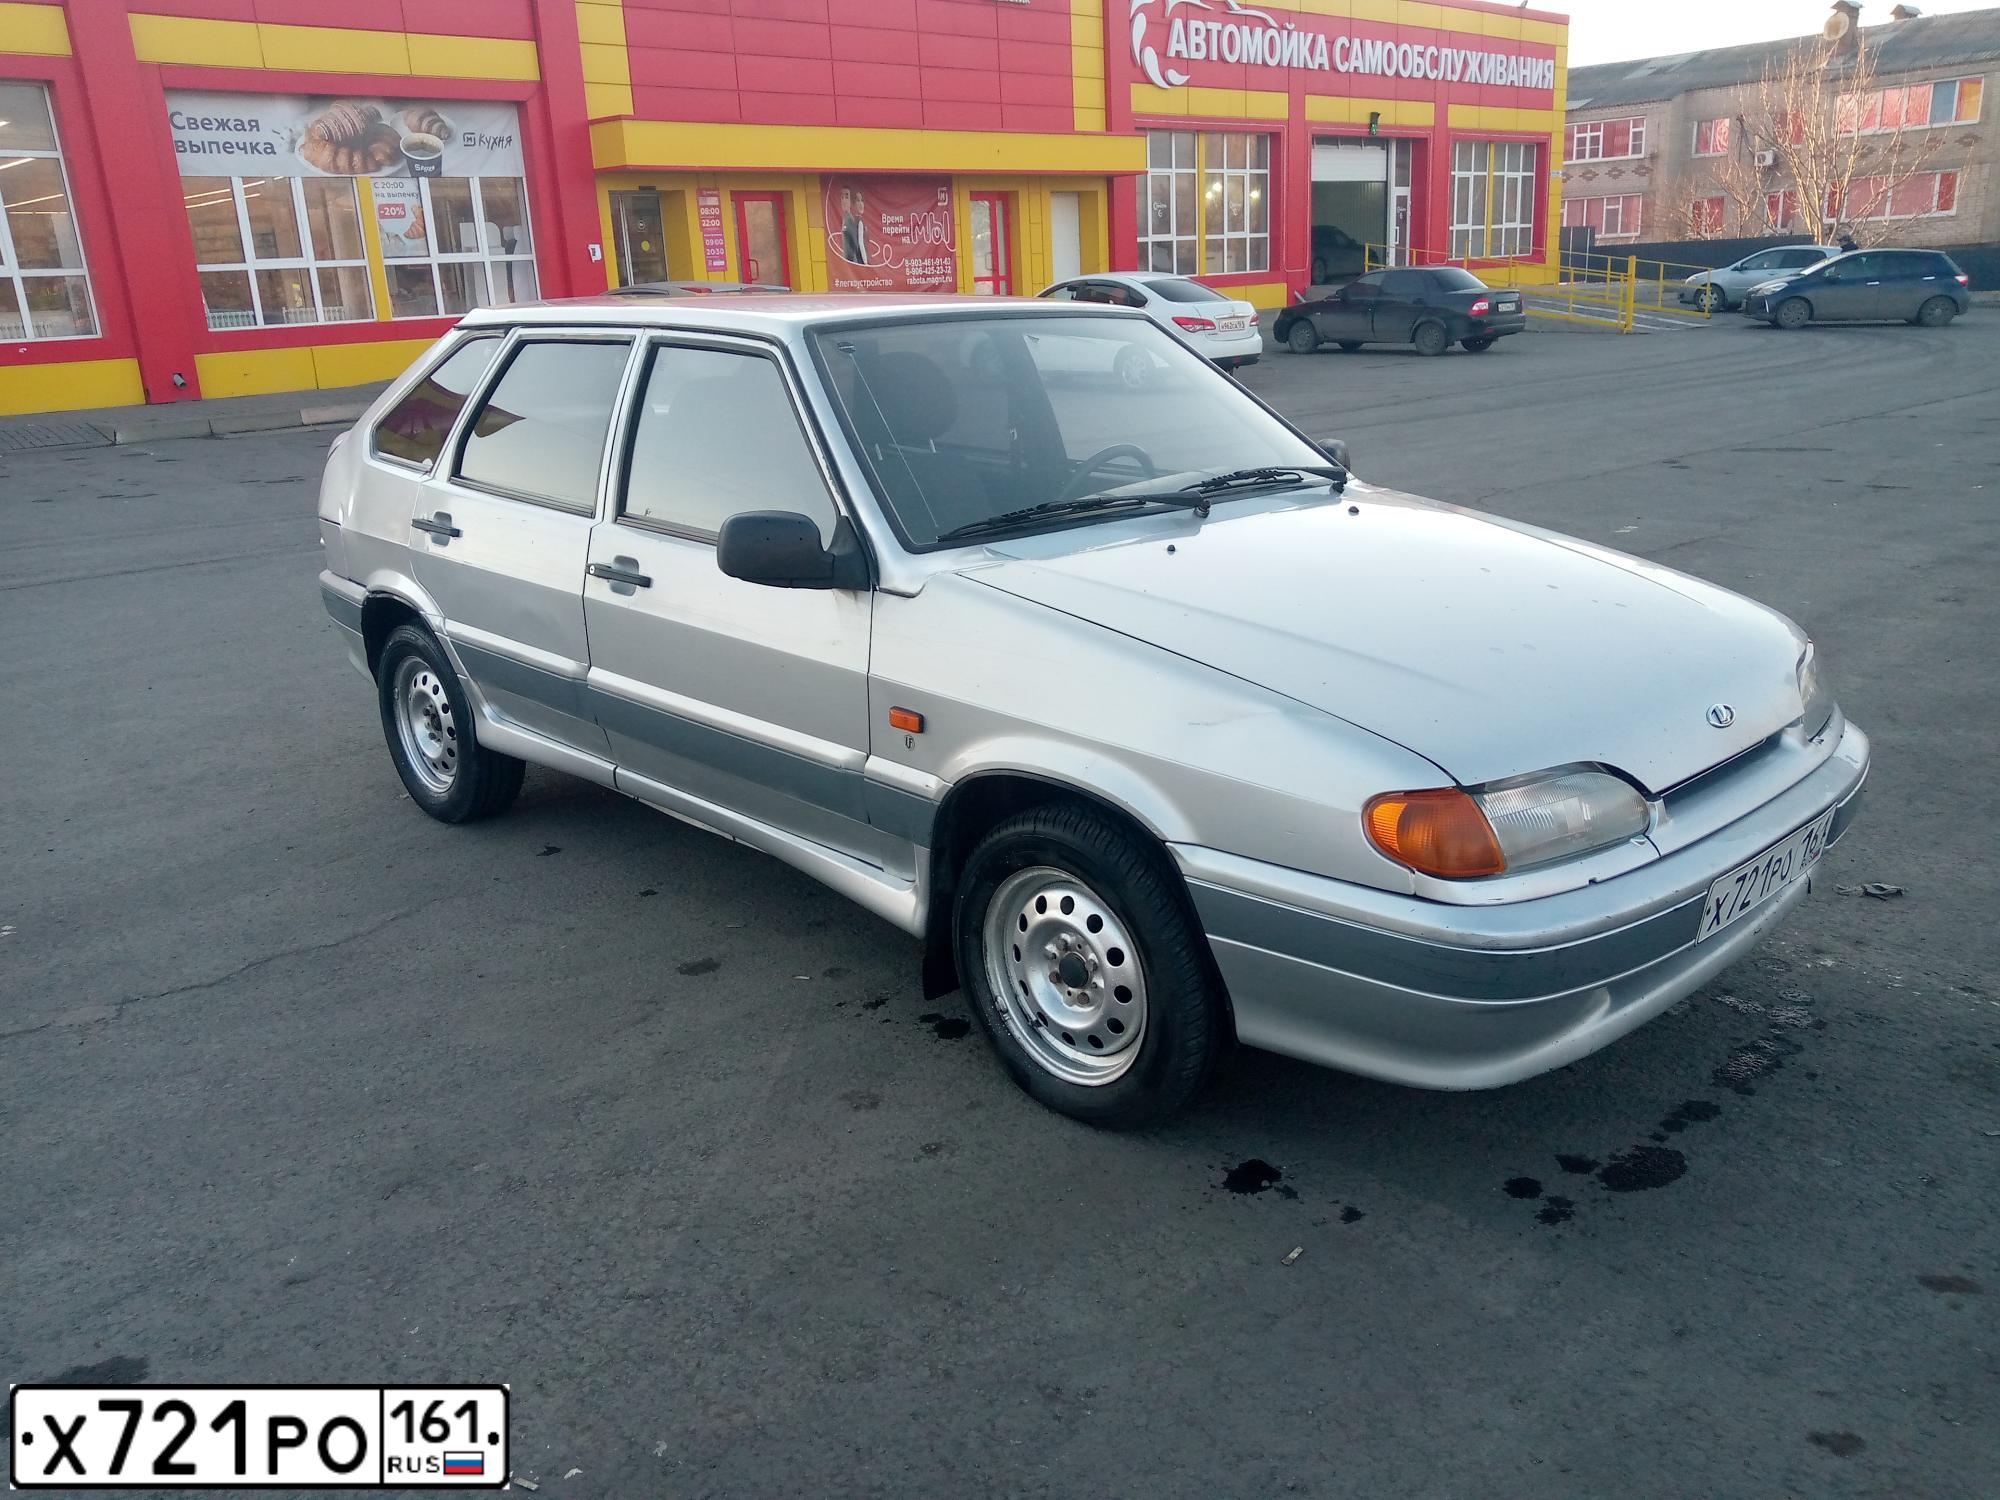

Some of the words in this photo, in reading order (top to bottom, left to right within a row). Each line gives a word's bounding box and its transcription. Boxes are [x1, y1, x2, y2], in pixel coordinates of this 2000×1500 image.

[1167, 18, 1329, 71] АВТОМОЙКА
[1333, 35, 1555, 90] САМООБСЛУЖИВАНИЯ
[169, 111, 260, 132] Свежая
[174, 140, 277, 155] выпечка
[387, 192, 419, 200] выпечку
[380, 206, 405, 216] -20%
[702, 219, 721, 227] 22:00
[881, 213, 904, 224] Время
[882, 224, 911, 236] перейти
[902, 236, 911, 244] на
[911, 211, 950, 245] МЫ
[834, 277, 893, 289] #легкоустройство
[1707, 848, 1793, 932] Х721РО
